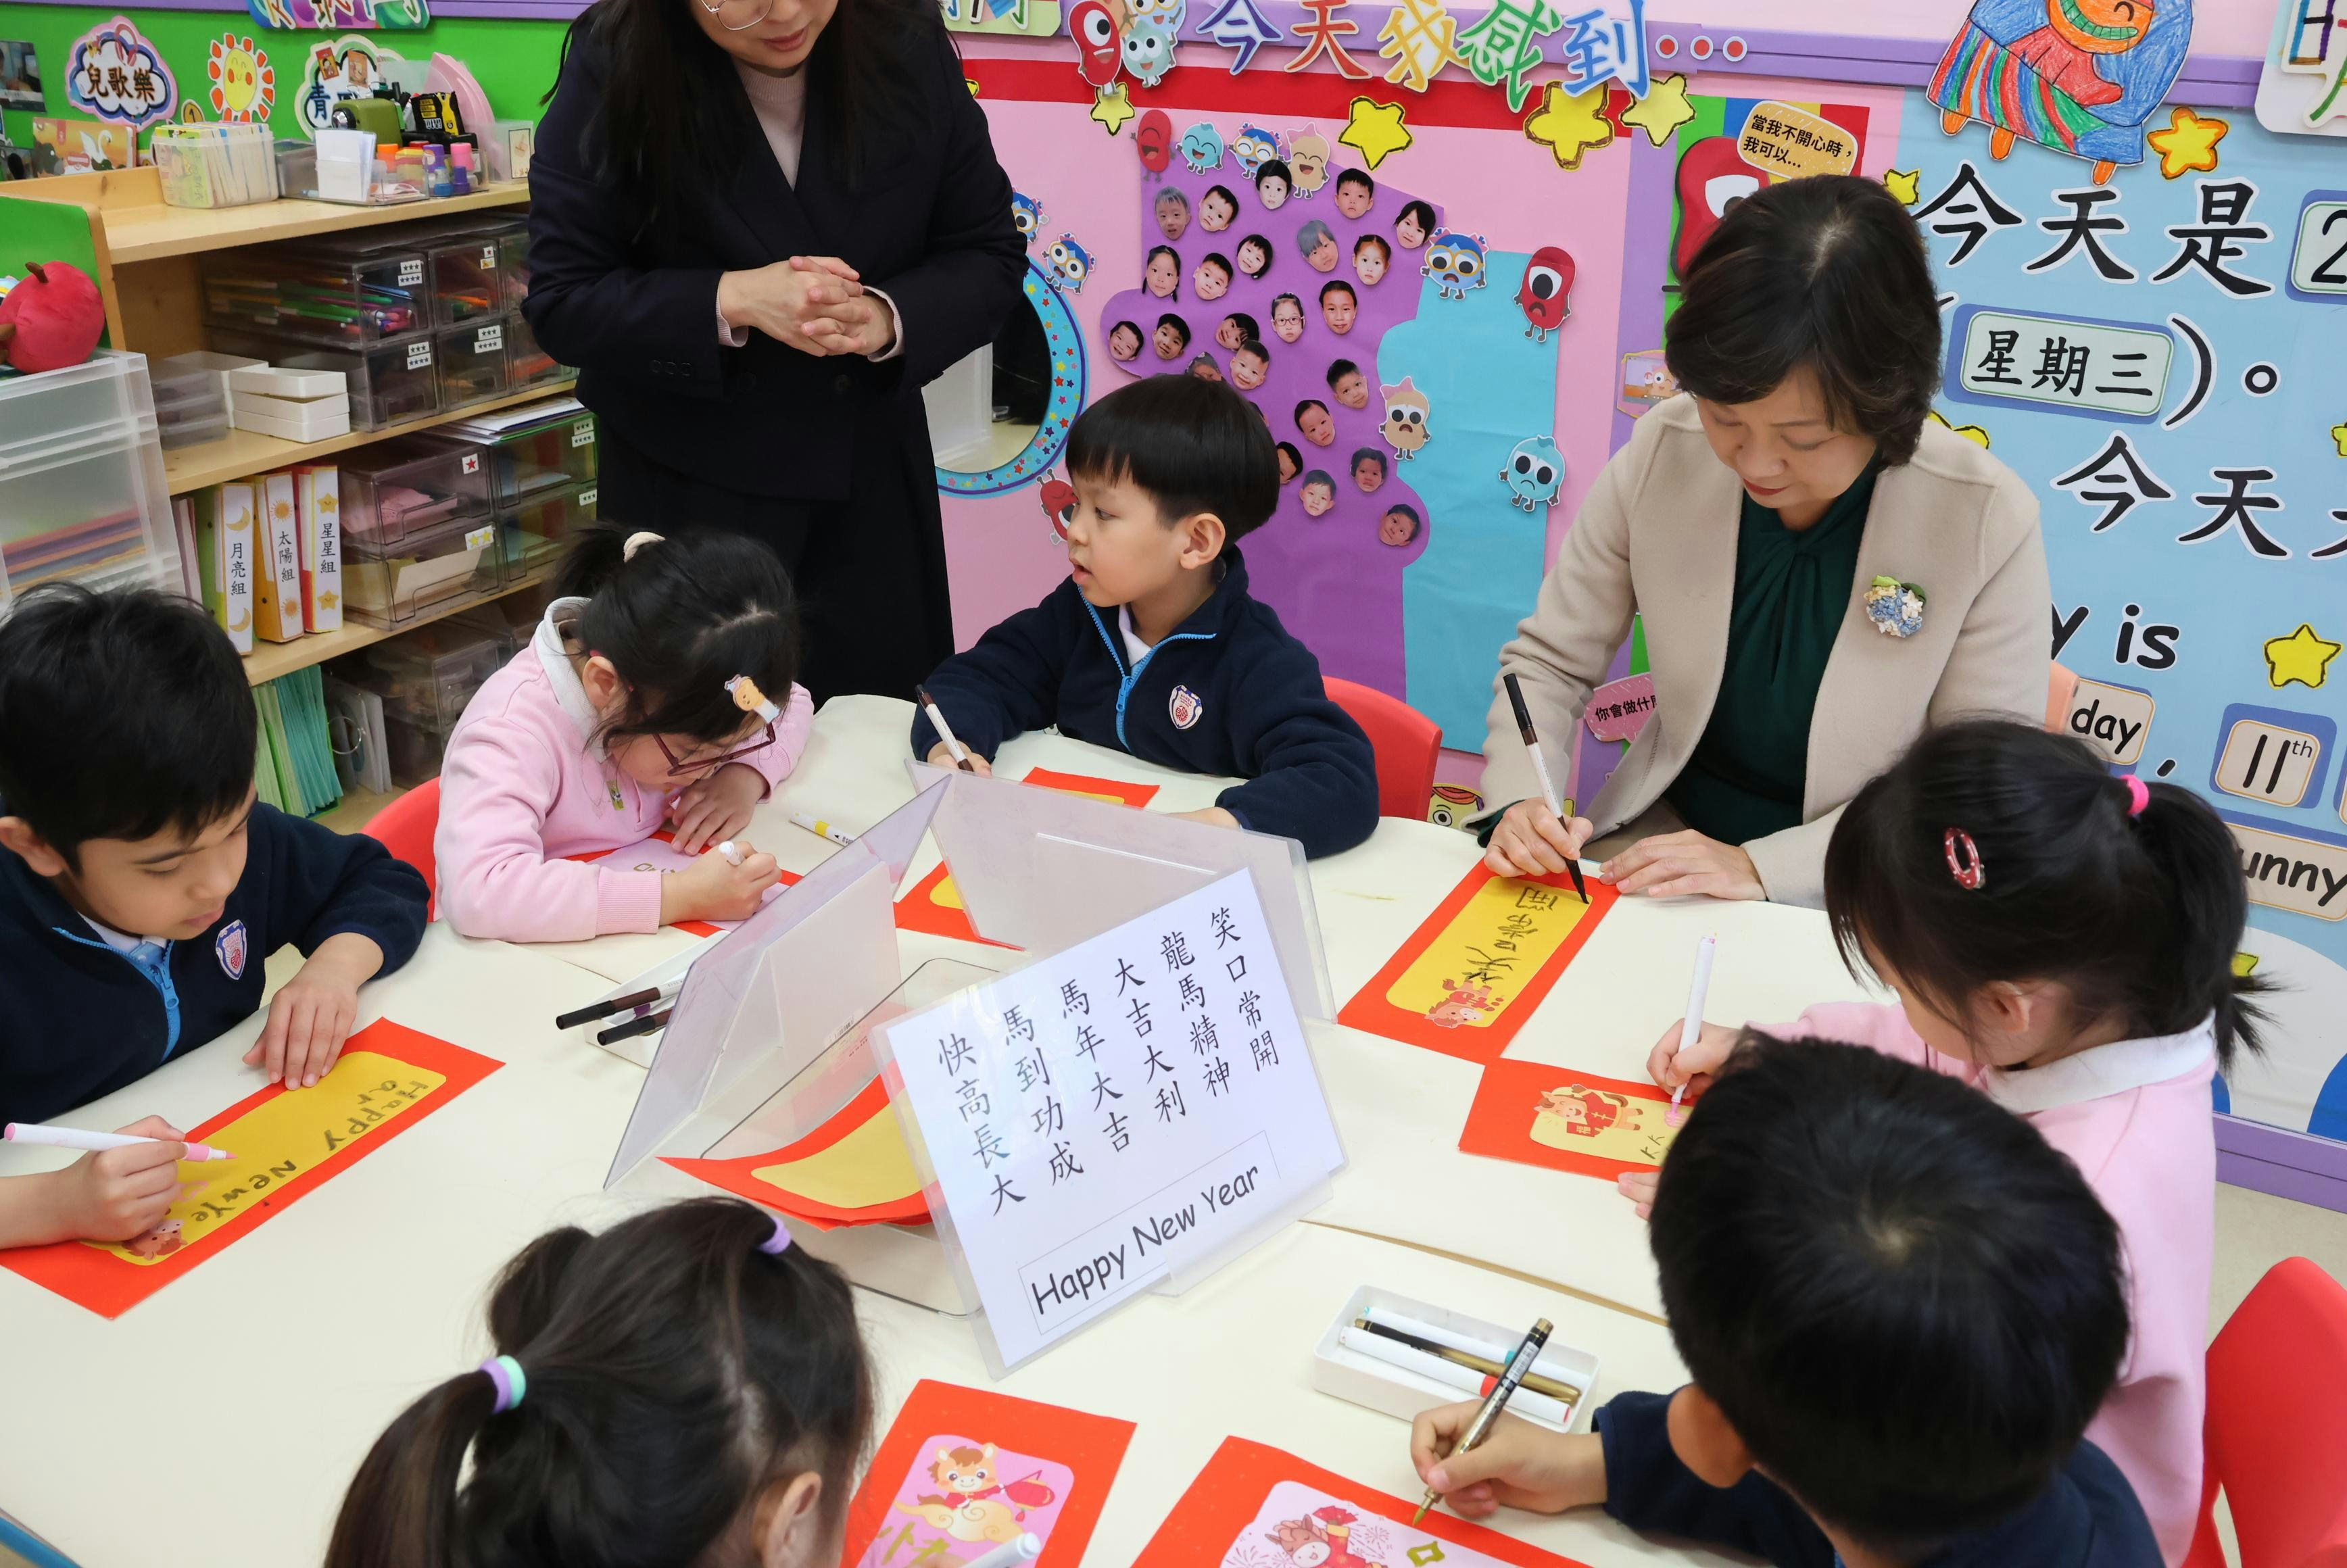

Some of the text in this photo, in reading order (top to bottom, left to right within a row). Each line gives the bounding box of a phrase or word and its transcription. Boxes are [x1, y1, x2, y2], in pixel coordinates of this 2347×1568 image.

[87, 63, 155, 103] 兒歌樂
[1911, 164, 2272, 295] 今天是
[230, 542, 247, 595] 月亮組
[278, 531, 295, 583] 太陽組
[320, 522, 337, 574] 星星組
[2116, 604, 2180, 670] is
[1461, 886, 1559, 985] 笑口常開
[2238, 848, 2347, 906] unny
[1114, 958, 1187, 1123] 大吉大利
[1160, 931, 1230, 1098] 龍馬精神
[1210, 906, 1280, 1073] 笑口常開
[938, 1032, 1027, 1217] 快高長大
[1002, 1004, 1085, 1186] 馬到功成
[1060, 978, 1132, 1153] 馬年大吉
[1031, 1165, 1259, 1315] Happy New Year
